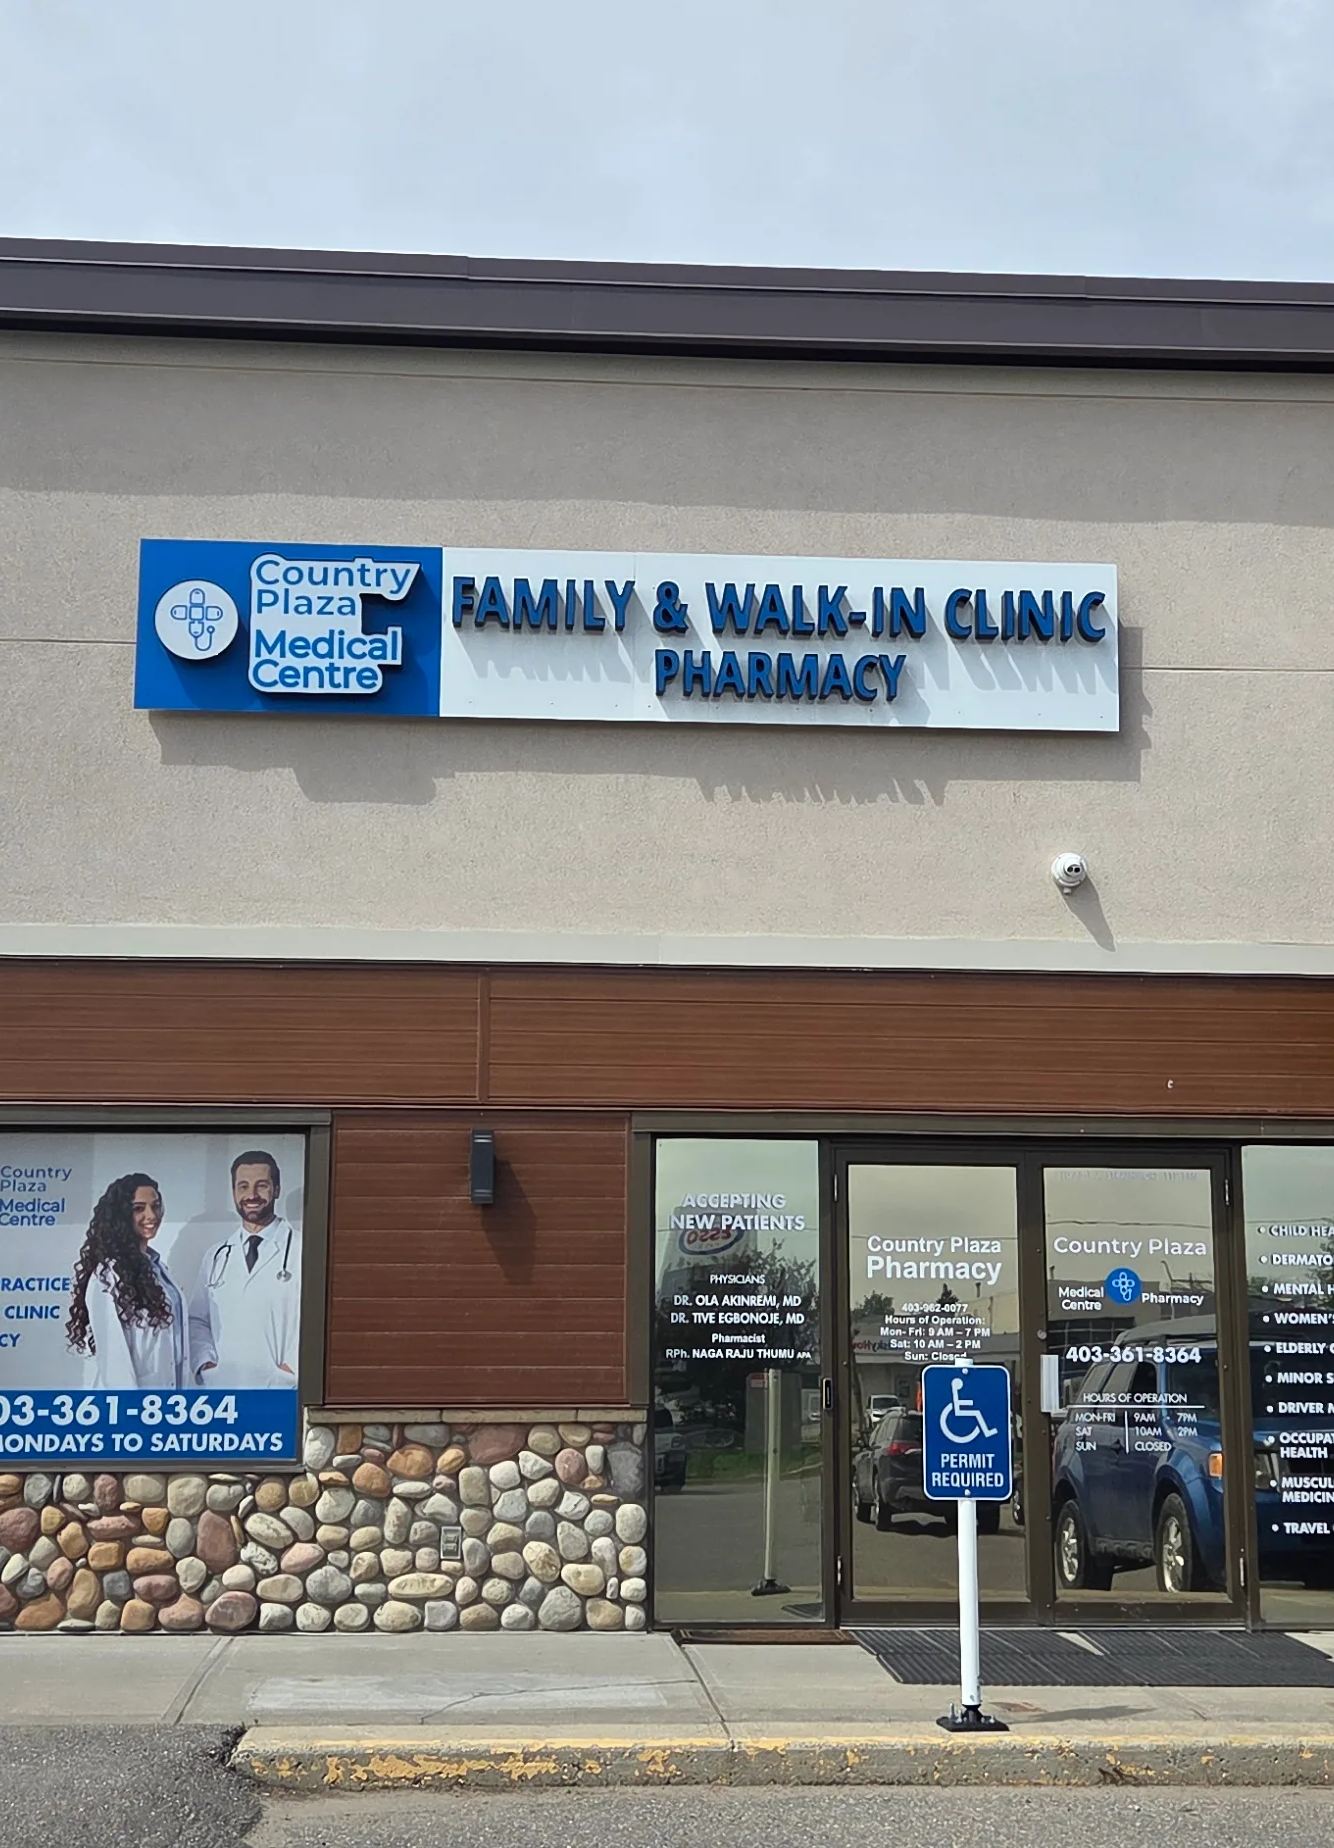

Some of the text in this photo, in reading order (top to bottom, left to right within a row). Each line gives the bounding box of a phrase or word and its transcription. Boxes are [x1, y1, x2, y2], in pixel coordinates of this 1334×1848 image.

[256, 560, 411, 594] Country
[257, 588, 356, 616] Plaza
[452, 576, 1105, 642] FAMILY & WALK-IN CLINIC
[255, 629, 398, 660] Medical
[253, 659, 378, 689] Centre
[655, 649, 907, 701] PHARMACY
[0, 1165, 72, 1182] Country
[0, 1179, 46, 1193] Plaza
[682, 1193, 786, 1209] ACCEPTING
[670, 1215, 805, 1230] NEW PATIENTS
[1270, 1225, 1307, 1236] CHILD
[868, 1235, 1001, 1256] Country Plaza
[1053, 1237, 1207, 1258] Country Plaza
[868, 1256, 1002, 1285] Pharmacy
[710, 1274, 765, 1284] PHYSICIANS
[1058, 1286, 1104, 1298] Medical
[1274, 1283, 1324, 1295] MENTAL
[673, 1295, 802, 1309] DR. OLA AKINREMI, MD
[1061, 1300, 1102, 1310] Centre
[1141, 1293, 1204, 1306] Pharmacy
[4, 1305, 60, 1320] CLINIC
[671, 1312, 805, 1326] DR. TIVE EGBONOJE, MD
[885, 1315, 985, 1326] Hours of Operation:
[711, 1333, 766, 1344] Pharmacist
[928, 1327, 935, 1336] 9
[936, 1327, 954, 1337] AM
[965, 1327, 972, 1337] 7
[974, 1327, 991, 1337] PM
[890, 1339, 910, 1349] Sat:
[913, 1339, 925, 1349] 10
[927, 1339, 944, 1349] AM
[955, 1340, 963, 1349] 2
[964, 1340, 981, 1349] PM
[1276, 1342, 1327, 1354] ELDERLY
[665, 1348, 690, 1359] RPh.
[692, 1349, 723, 1359] NAGA
[725, 1349, 754, 1359] RAJU
[756, 1349, 794, 1359] THUMU
[904, 1352, 928, 1361] Sun:
[1066, 1346, 1201, 1363] 403-361-8364
[1277, 1373, 1323, 1384] MINOR
[1083, 1393, 1187, 1404] HOURS OF OPERATION
[1278, 1402, 1324, 1413] DRIVER
[1075, 1412, 1116, 1423] MON-FRI
[1134, 1413, 1156, 1423] 9AM
[1177, 1413, 1198, 1423] 7PM
[1075, 1426, 1093, 1436] SAT
[1135, 1426, 1162, 1436] 10AM
[1177, 1426, 1198, 1436] 2PM
[111, 1433, 143, 1452] TO
[149, 1433, 283, 1452] SATURDAYS
[1075, 1441, 1172, 1452] SUN CLOSED
[1280, 1447, 1328, 1458] HEALTH
[940, 1453, 995, 1469] PERMIT
[931, 1472, 1004, 1488] REQUIRED
[1283, 1523, 1330, 1534] TRAVEL
